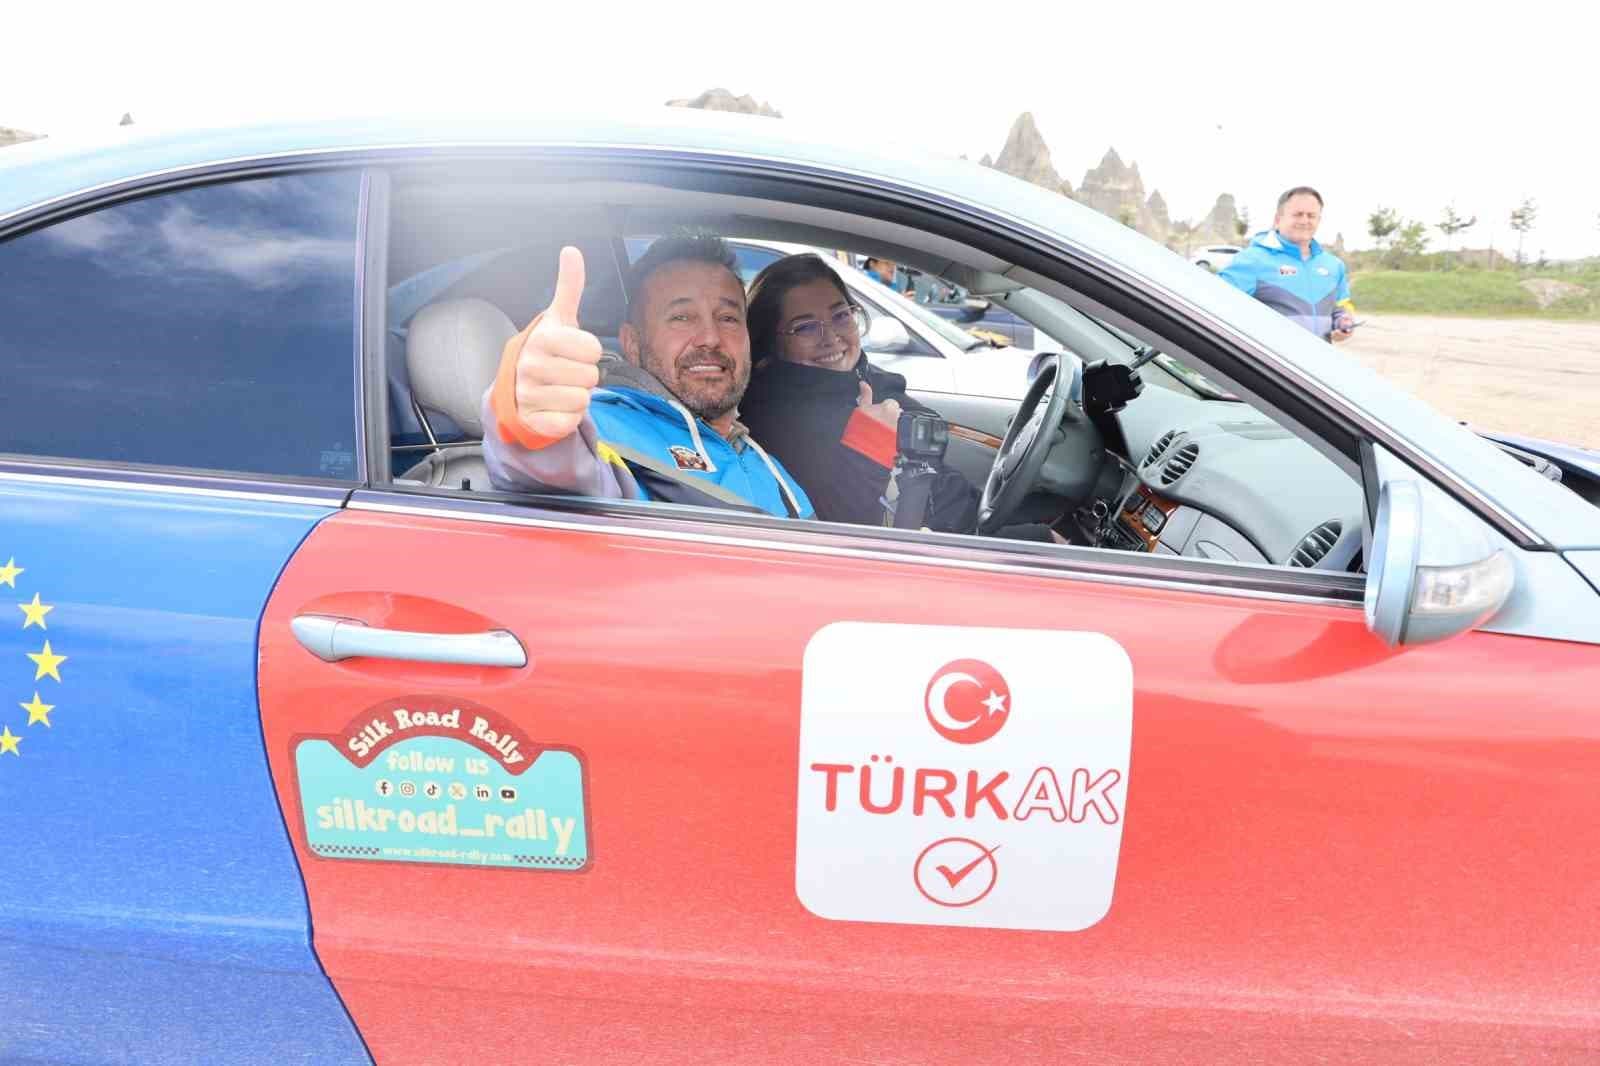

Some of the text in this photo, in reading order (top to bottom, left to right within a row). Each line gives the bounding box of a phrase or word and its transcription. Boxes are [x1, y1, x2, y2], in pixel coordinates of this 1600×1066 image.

[348, 708, 524, 764] Silk Road Rally
[387, 751, 490, 775] follow us
[811, 754, 1121, 825] TÜRKAK
[316, 797, 576, 856] silkroad_rally
